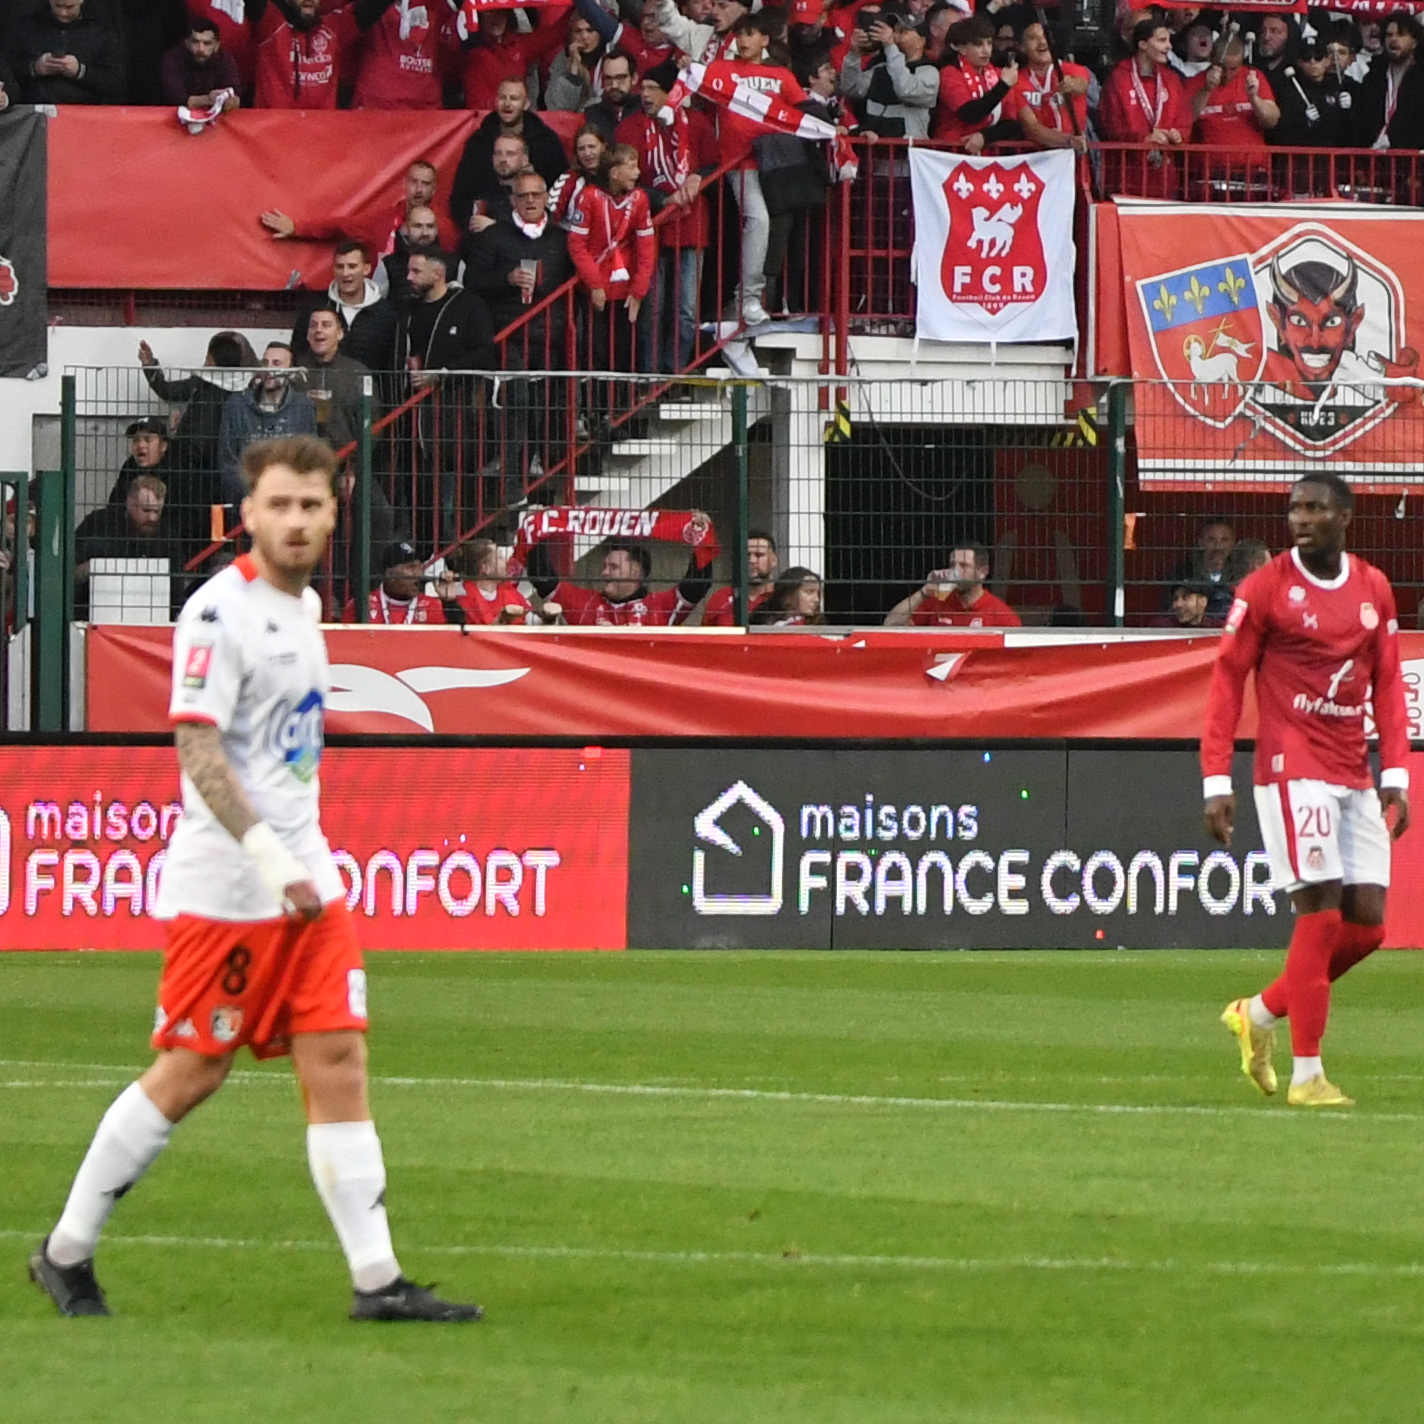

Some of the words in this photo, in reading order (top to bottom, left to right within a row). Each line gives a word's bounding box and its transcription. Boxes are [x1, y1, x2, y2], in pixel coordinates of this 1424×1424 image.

[520, 509, 661, 541] F.C.ROUEN
[26, 791, 182, 841] maison
[801, 792, 978, 841] maisons
[1298, 804, 1331, 838] 20
[343, 848, 562, 916] ONFORT
[799, 849, 1031, 916] FRANCE
[1040, 849, 1277, 916] CONFOR
[222, 946, 250, 995] 8
